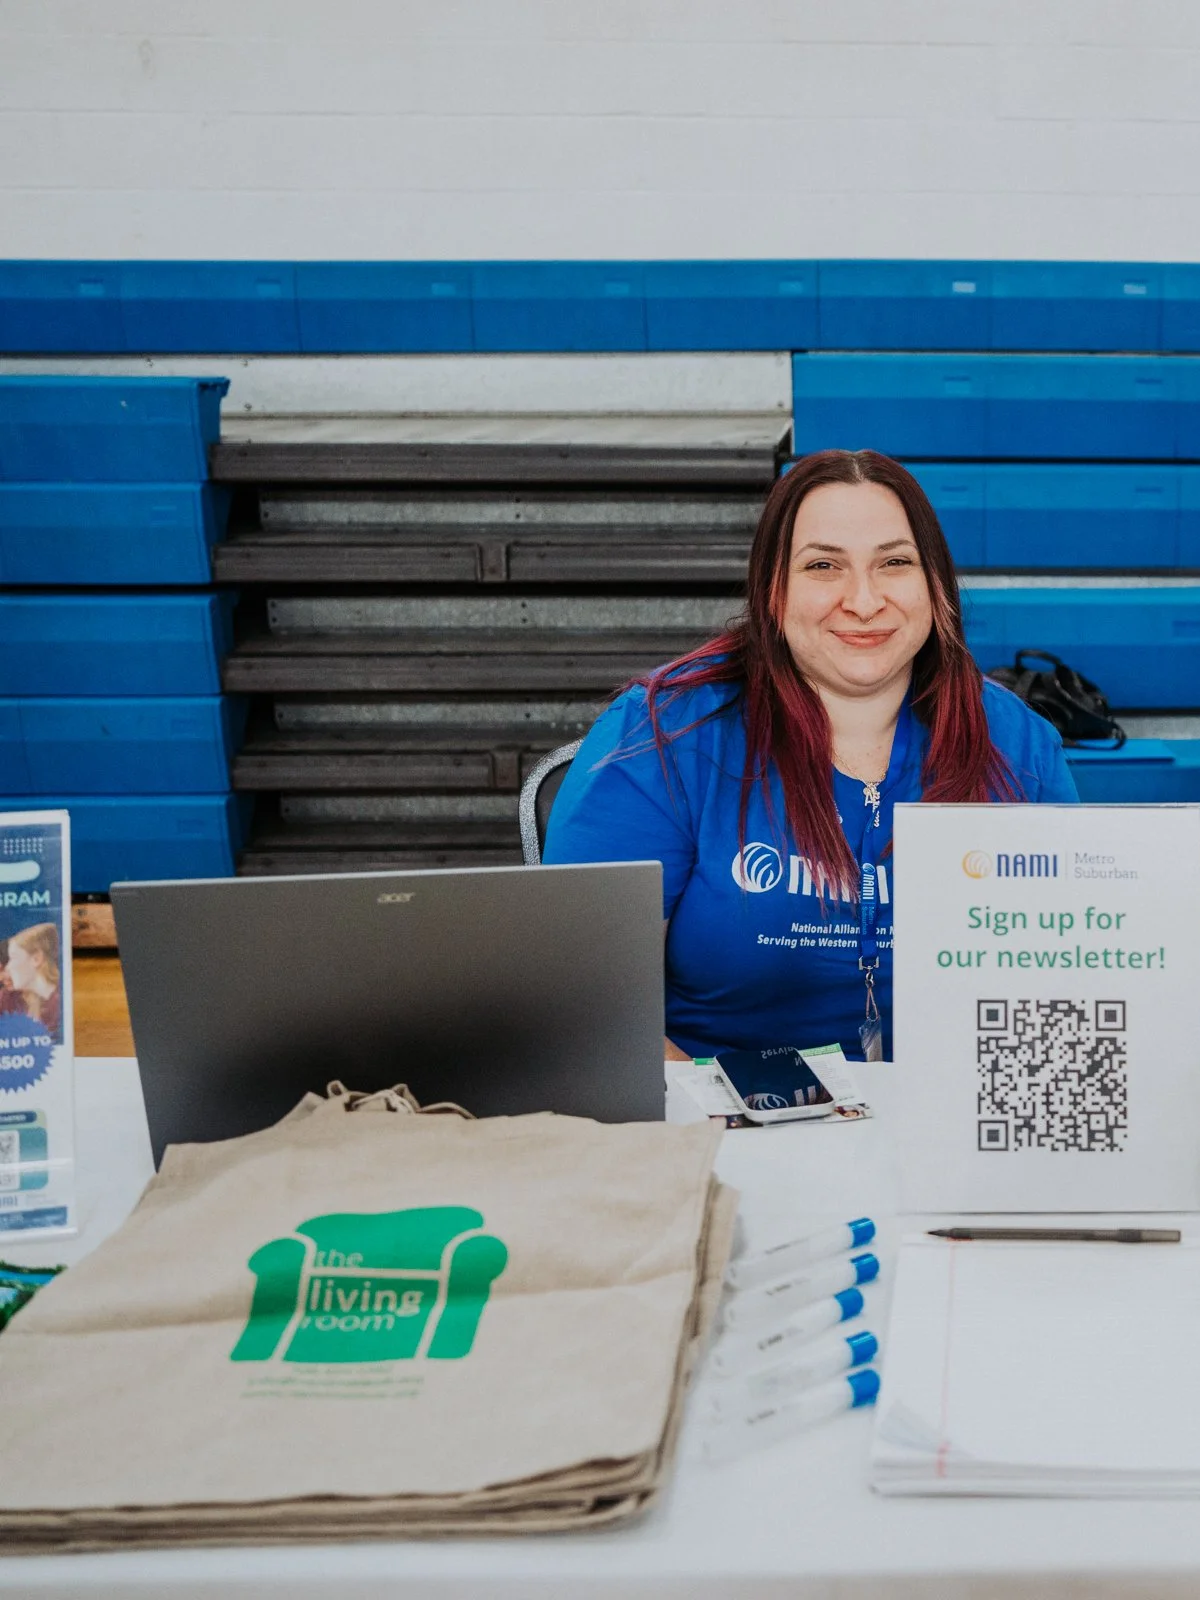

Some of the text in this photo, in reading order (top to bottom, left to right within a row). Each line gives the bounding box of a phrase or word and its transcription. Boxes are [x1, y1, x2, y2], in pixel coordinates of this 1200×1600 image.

[996, 852, 1116, 877] NAMI Metro
[1074, 867, 1139, 880] Suburban
[862, 874, 876, 900] NAMI
[0, 889, 50, 908] RAM
[377, 892, 416, 904] acer
[791, 922, 832, 935] National
[834, 923, 861, 935] Allian
[967, 906, 1127, 936] Sign up for
[757, 934, 858, 949] Serving the Western
[936, 945, 1166, 969] our newsletter!
[12, 1037, 31, 1048] UP
[33, 1035, 50, 1047] TO
[0, 1054, 35, 1070] 500
[316, 1249, 364, 1268] the
[309, 1278, 424, 1318] living
[299, 1314, 395, 1331] room
